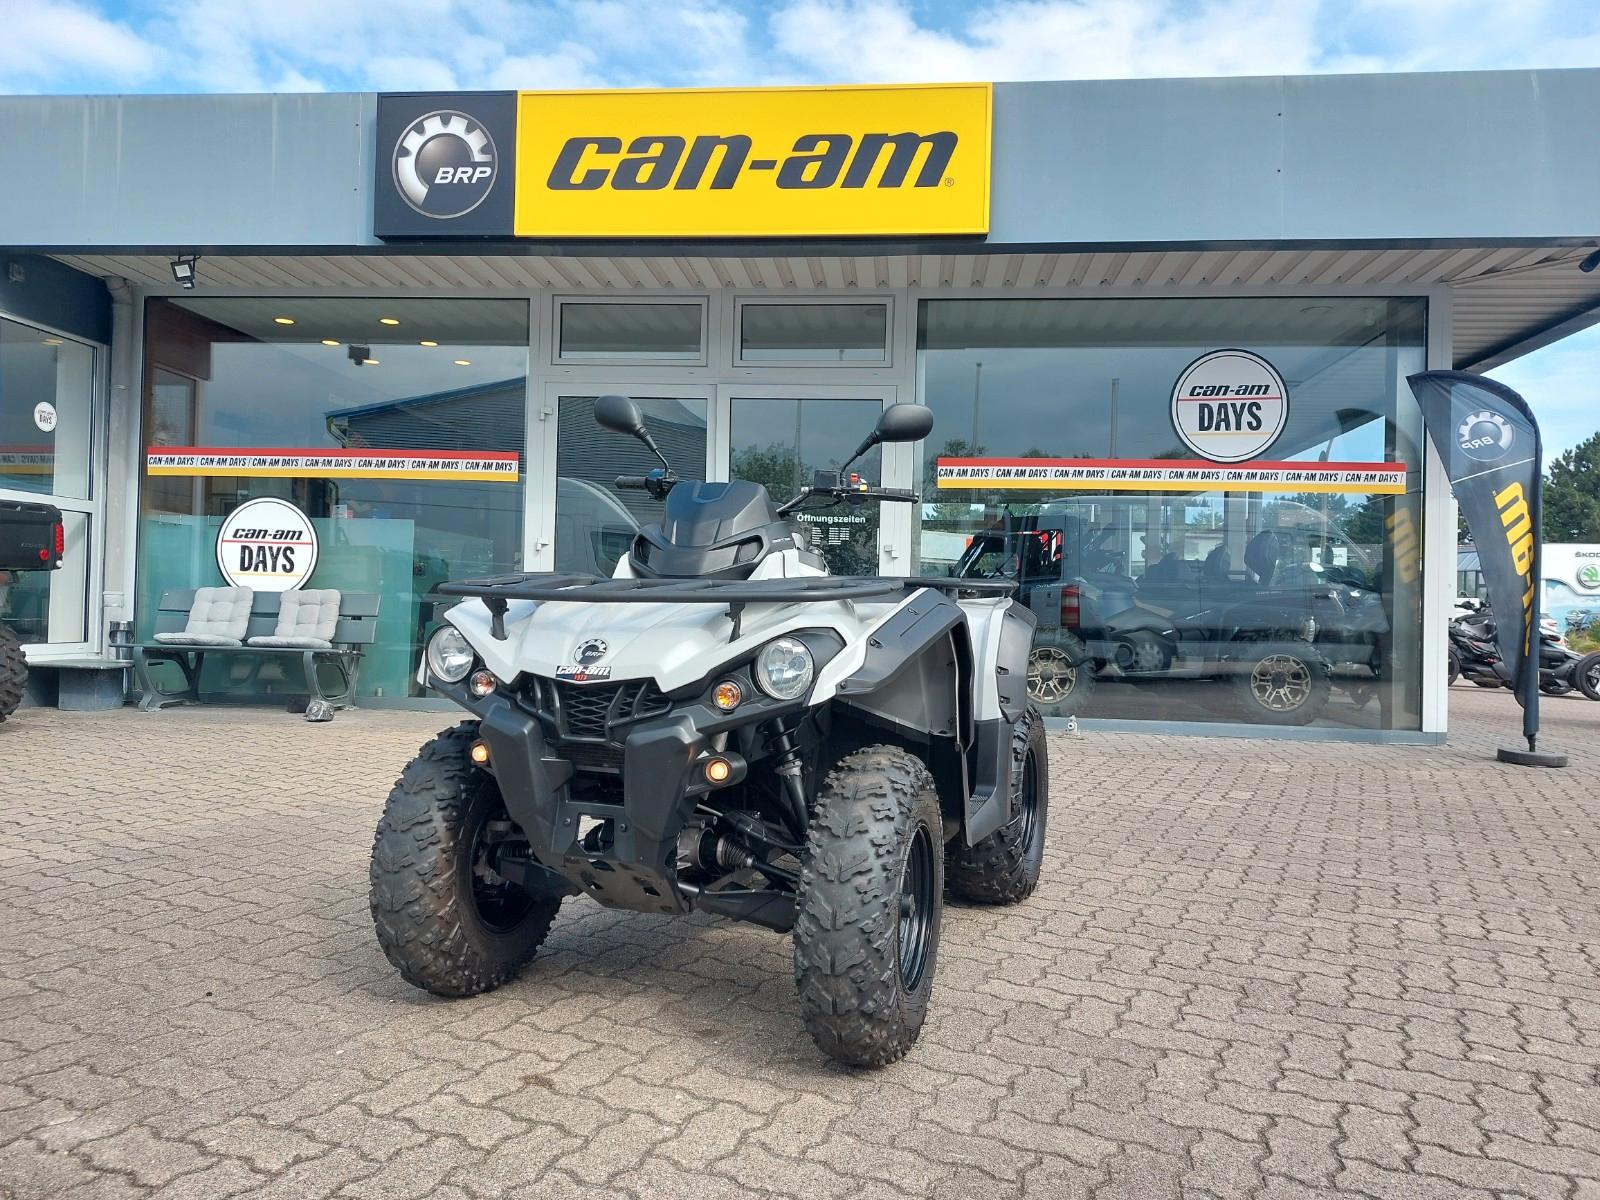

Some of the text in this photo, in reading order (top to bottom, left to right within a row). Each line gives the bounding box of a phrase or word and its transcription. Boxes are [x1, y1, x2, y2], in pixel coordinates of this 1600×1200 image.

[546, 131, 959, 190] can-am
[434, 166, 492, 185] BRP
[1189, 384, 1270, 397] can-am
[1198, 401, 1262, 431] DAYS
[148, 456, 513, 471] CAN-AM DAYS CAN-AM DAYS CAN-AM DAYS CAN-AM DAYS CAN-AM DAYS CAN-AM DAYS CAN-AM DAYS
[938, 468, 1398, 482] CAN-AM DAYS CAN-AM DAYS CAN-AM DAYS CAN-AM DAYS CAN-AM DAYS CAN-AM DAYS CAN-AM DAYS CAN-AM DAYS
[797, 512, 866, 524] Öffnungszeiten
[232, 528, 303, 540] can-am
[240, 545, 295, 573] DAYS
